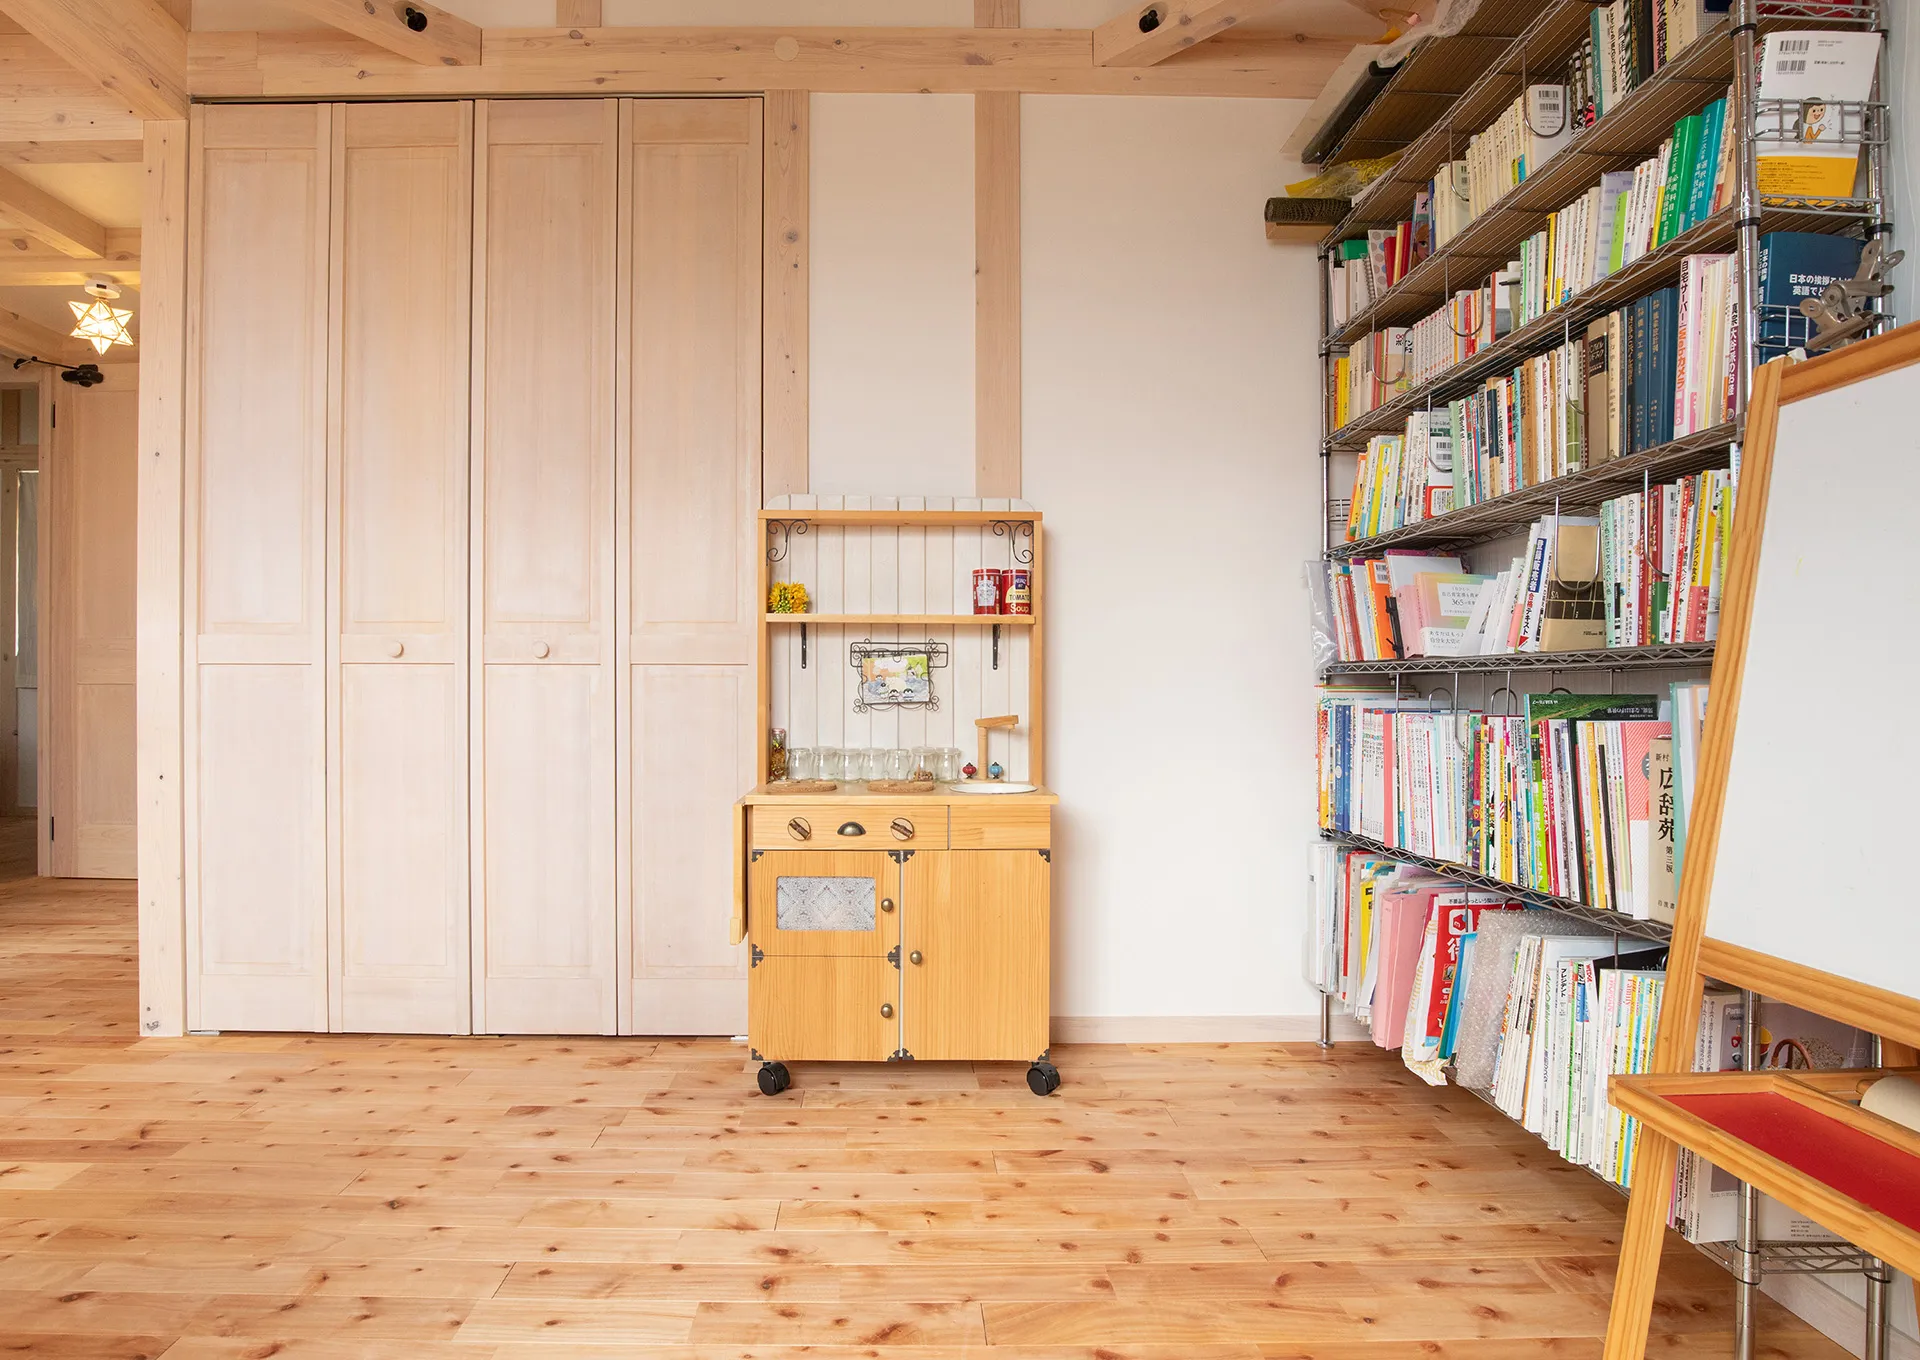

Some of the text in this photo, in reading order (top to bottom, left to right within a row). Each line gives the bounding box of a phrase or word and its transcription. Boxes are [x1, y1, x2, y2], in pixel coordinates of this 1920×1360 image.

[1010, 603, 1029, 613] Soup
[1658, 767, 1674, 843] 広辞苑
